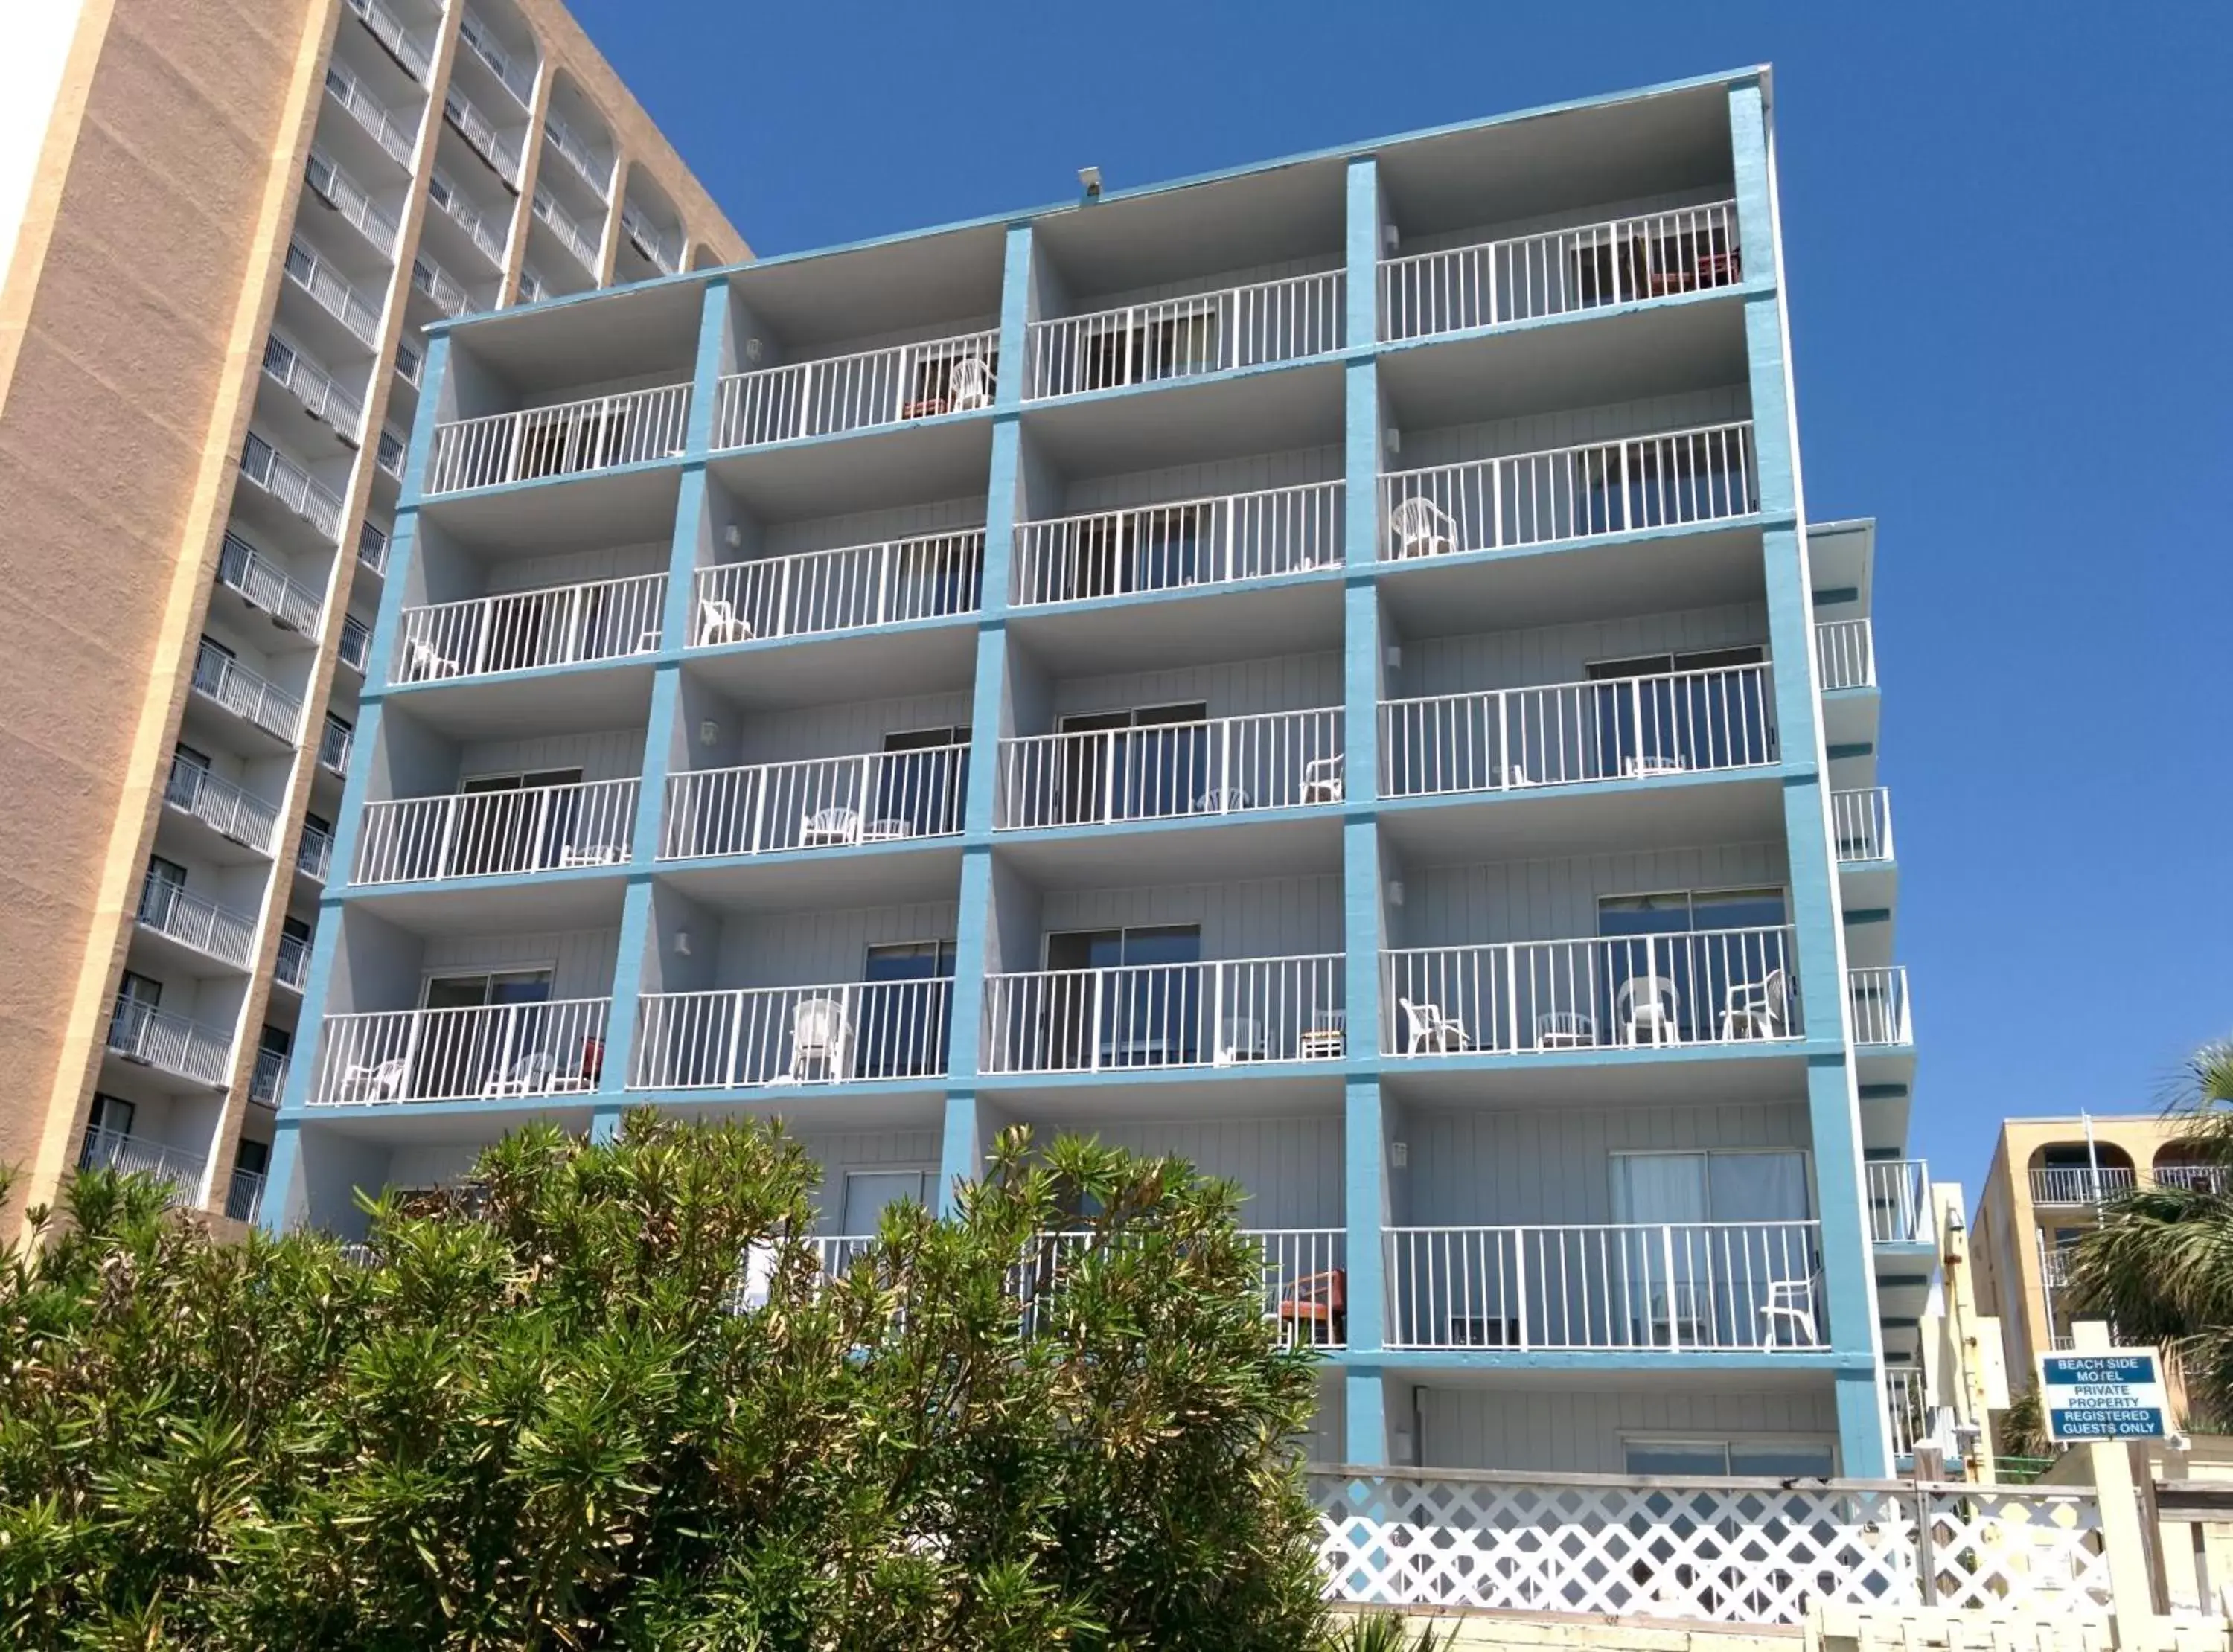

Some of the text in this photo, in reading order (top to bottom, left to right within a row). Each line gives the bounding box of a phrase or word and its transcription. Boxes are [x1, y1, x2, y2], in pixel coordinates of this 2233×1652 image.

[2058, 1358, 2138, 1370] BEACH SIDE
[2077, 1371, 2123, 1382] MOTEL
[2075, 1385, 2130, 1395] PRIVATE
[2069, 1397, 2139, 1408] PROPERTY
[2065, 1410, 2149, 1421] REGISTERED
[2063, 1422, 2156, 1434] GUESTS ONLY
